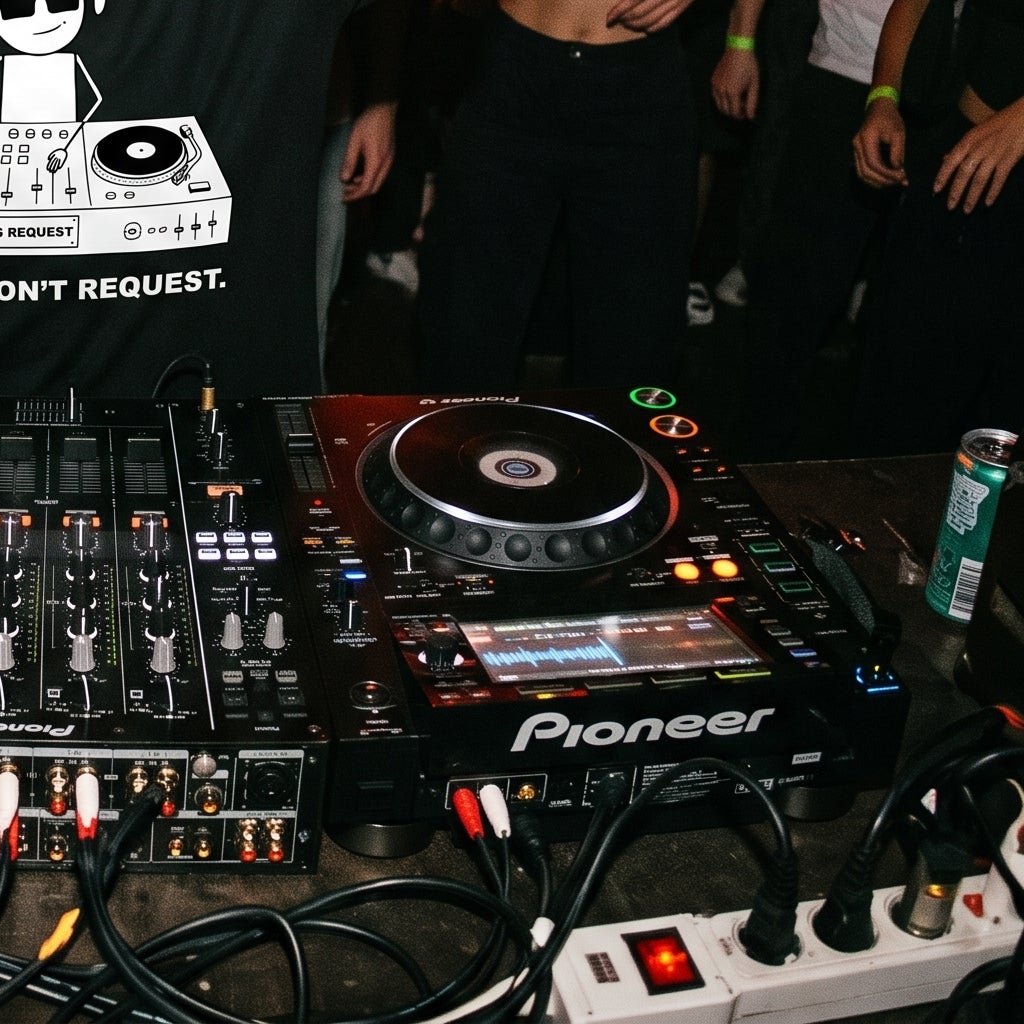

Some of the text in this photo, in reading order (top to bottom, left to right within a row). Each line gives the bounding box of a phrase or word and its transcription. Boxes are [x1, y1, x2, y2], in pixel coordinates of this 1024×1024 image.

[7, 226, 74, 238] REQUEST
[78, 267, 226, 300] REQUEST.
[510, 707, 776, 753] Pioneer
